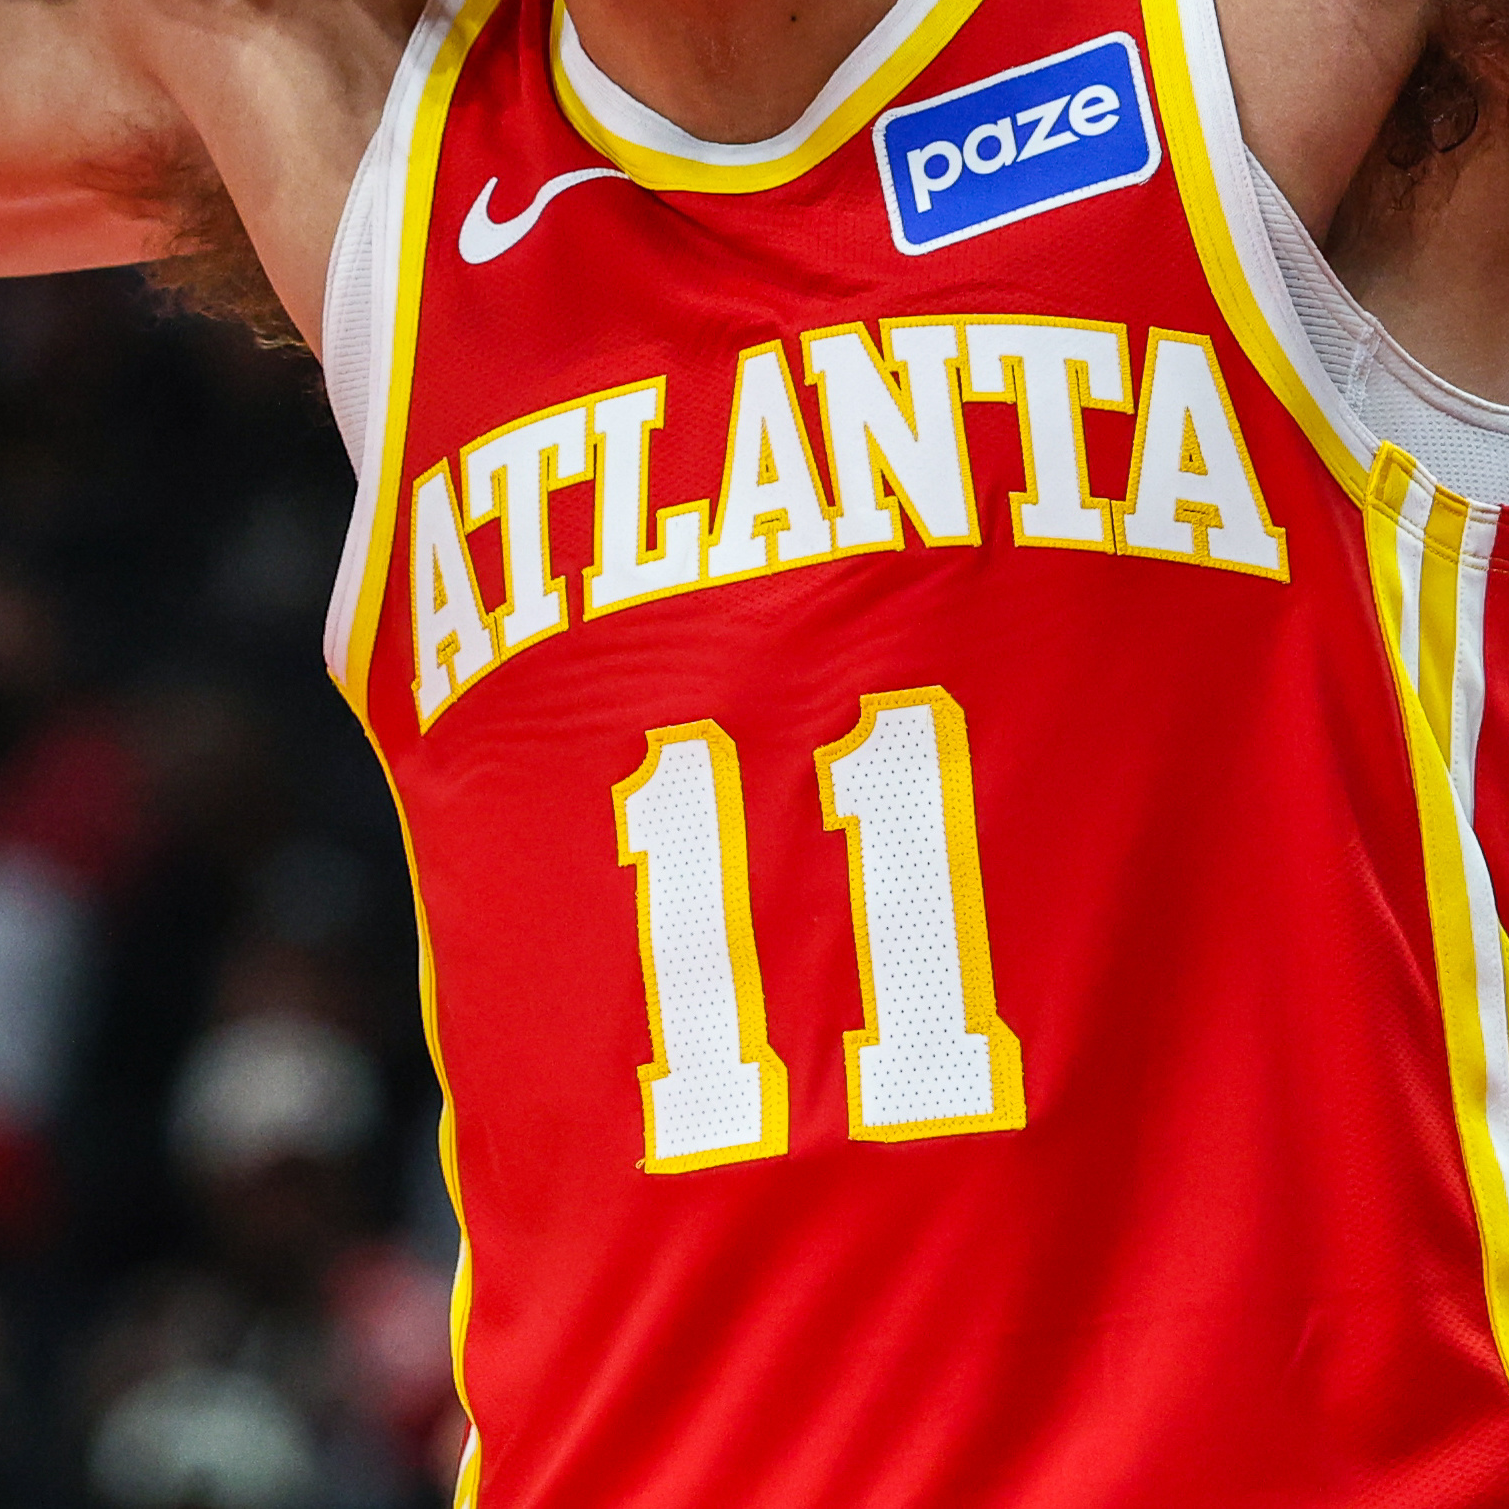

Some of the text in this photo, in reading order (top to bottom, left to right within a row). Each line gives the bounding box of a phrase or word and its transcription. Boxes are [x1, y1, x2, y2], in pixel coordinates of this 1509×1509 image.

[904, 82, 1122, 213] paze
[409, 315, 1290, 736] ATLANTA
[611, 684, 1027, 1175] 11
